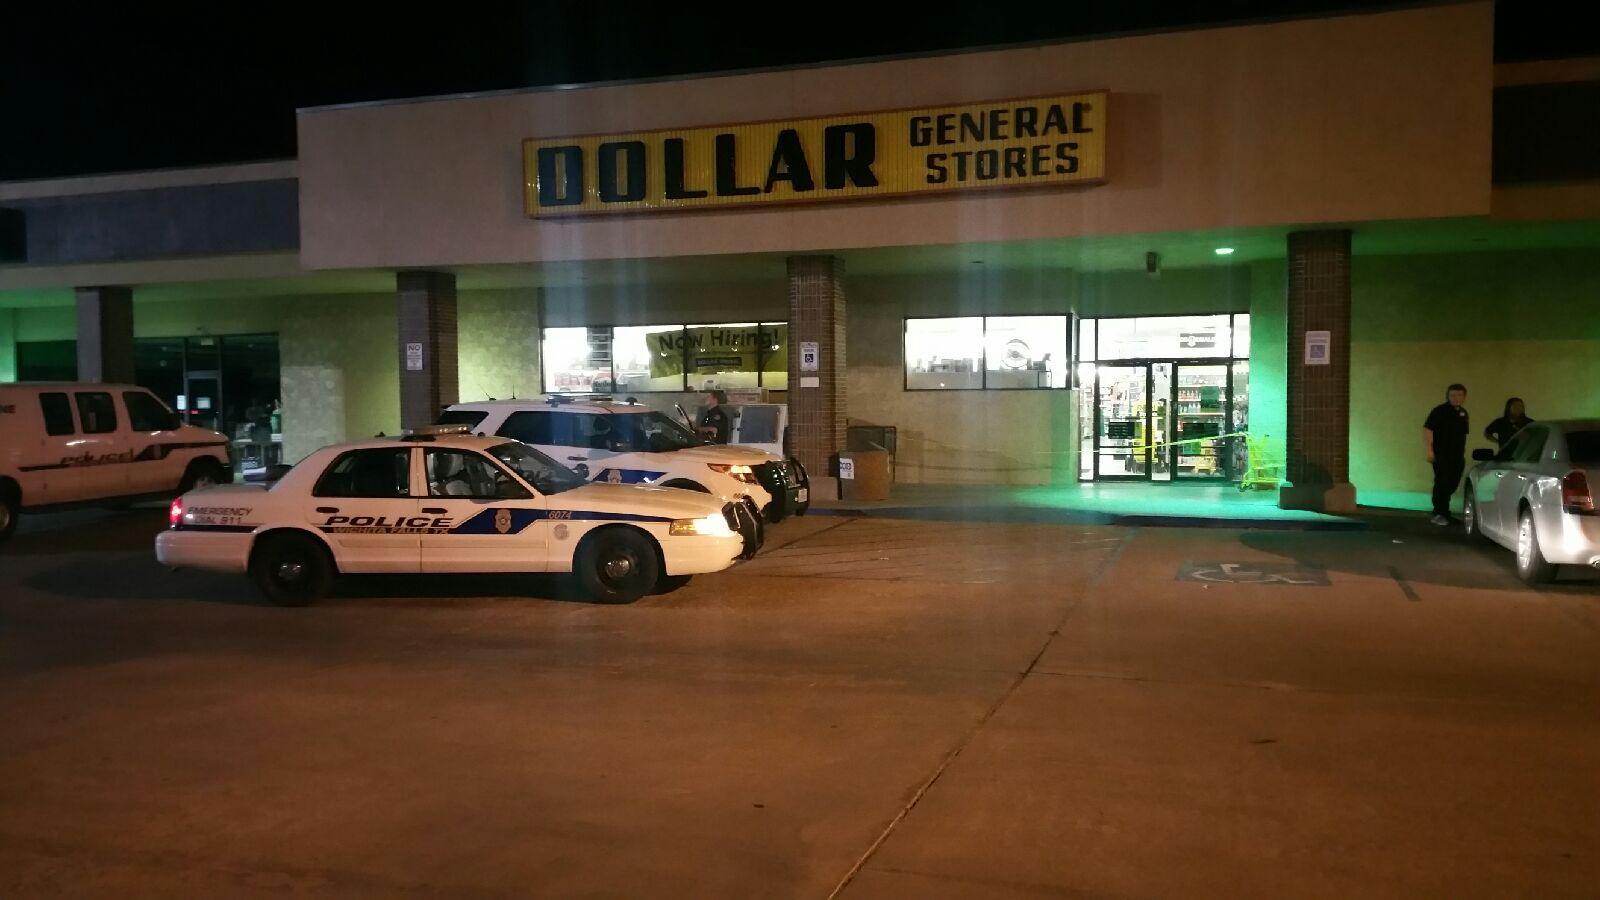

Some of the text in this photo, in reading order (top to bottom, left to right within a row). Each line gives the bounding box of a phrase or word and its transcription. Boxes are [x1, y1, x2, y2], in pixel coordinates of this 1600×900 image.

[910, 102, 1093, 147] GENERAL
[538, 122, 879, 207] DOLLAR
[925, 142, 1079, 185] STORES
[658, 327, 779, 352] Now Hiring!
[187, 506, 253, 516] EMERGENCY
[549, 510, 572, 520] 6074
[220, 516, 242, 525] 911
[325, 515, 454, 528] POLICE
[333, 526, 450, 535] WICHITA FALLS TX
